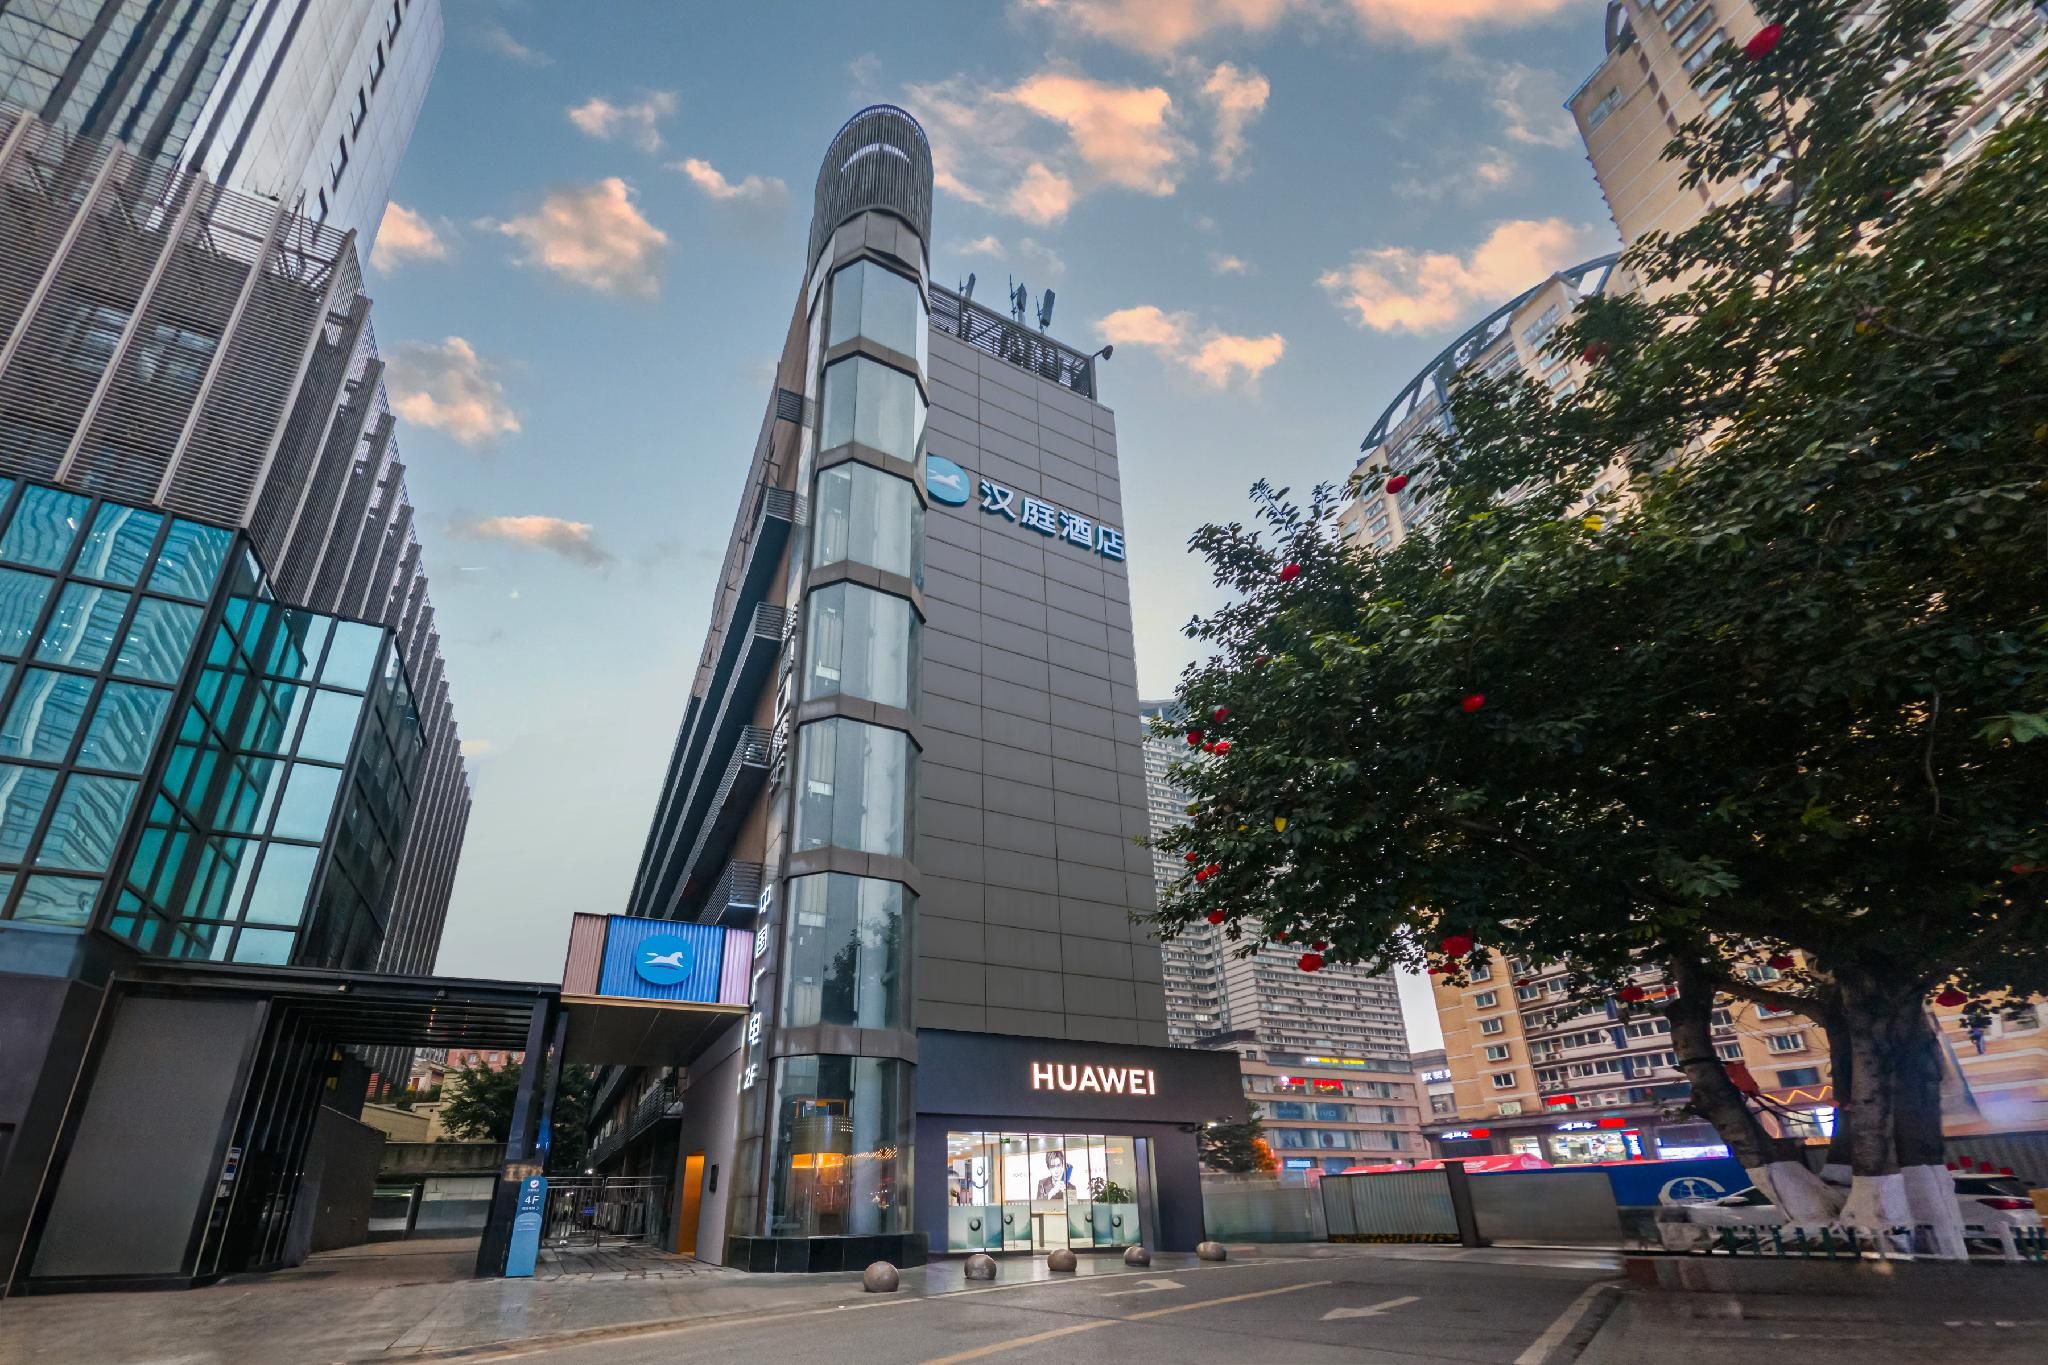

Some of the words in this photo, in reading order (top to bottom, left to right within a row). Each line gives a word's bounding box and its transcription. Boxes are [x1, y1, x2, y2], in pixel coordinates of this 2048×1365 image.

[979, 478, 1126, 560] 汉庭酒店
[1032, 1062, 1156, 1095] HUAWEI
[525, 1195, 540, 1205] 4F
